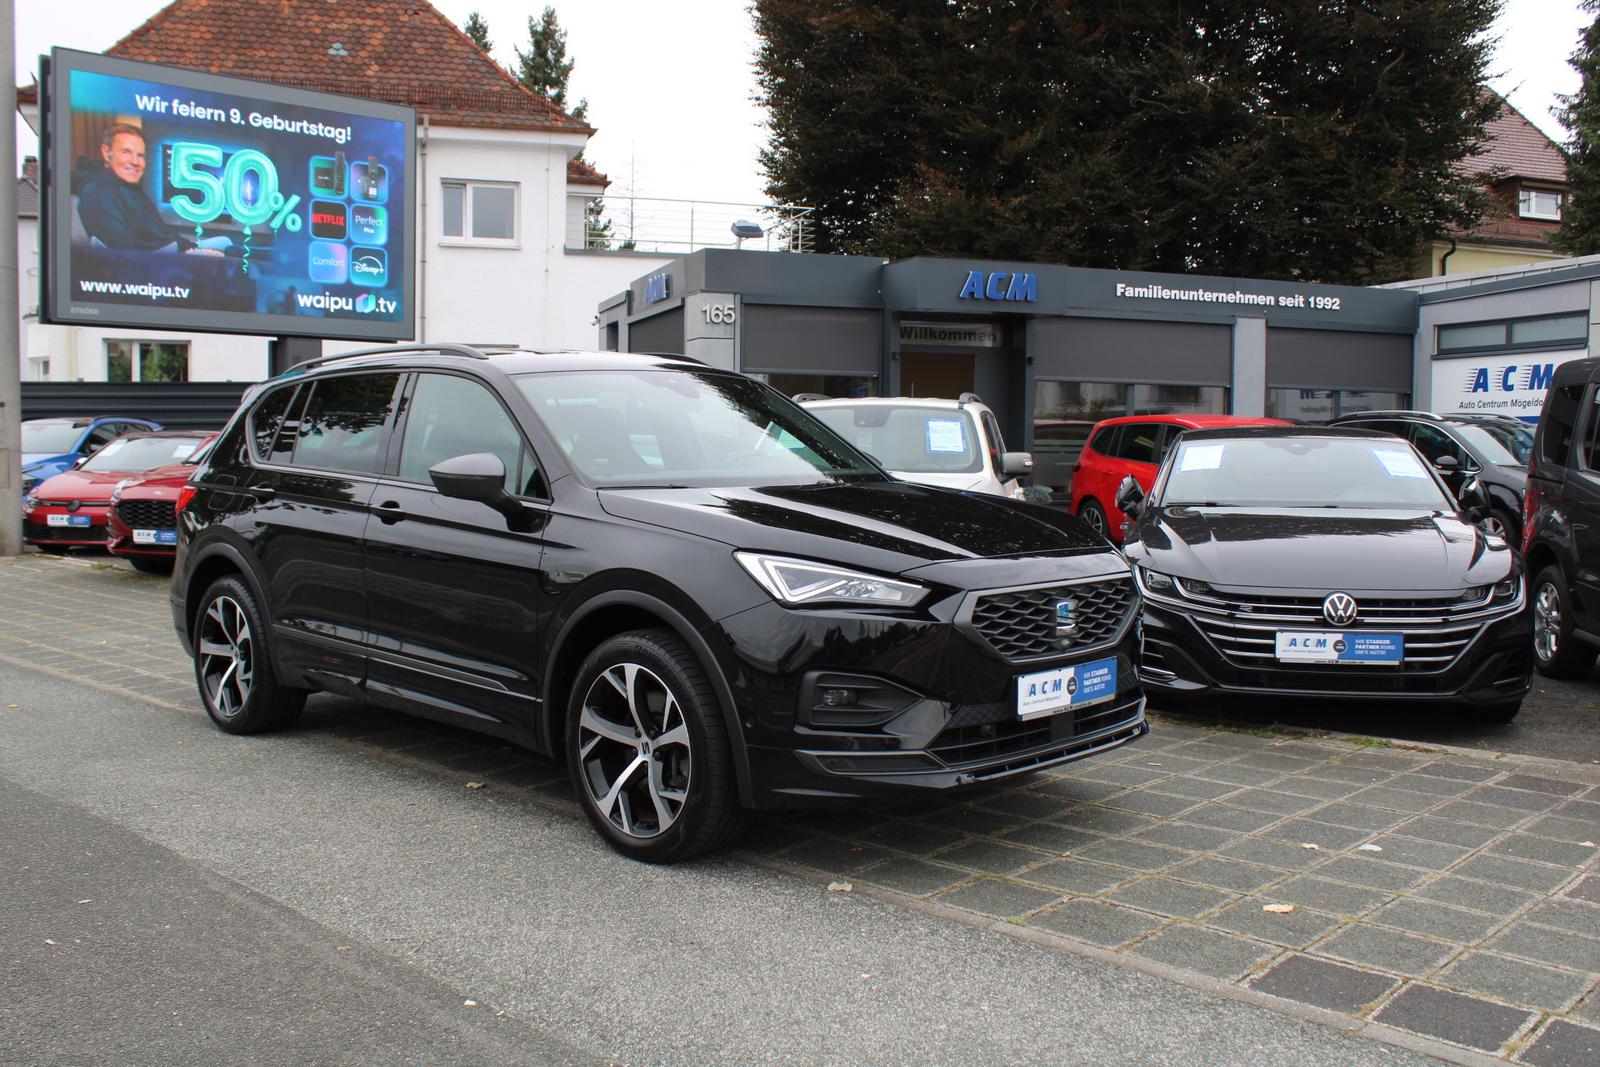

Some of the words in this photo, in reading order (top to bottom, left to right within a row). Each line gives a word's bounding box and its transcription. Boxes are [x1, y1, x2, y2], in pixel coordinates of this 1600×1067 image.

[135, 94, 168, 113] Wir
[172, 99, 225, 122] feiern
[230, 108, 245, 125] 9.
[249, 112, 352, 144] Geburtstag!
[170, 142, 302, 232] 50%
[312, 213, 344, 226] NETFLIX
[355, 215, 384, 227] Perfect
[313, 256, 344, 267] Comfort
[80, 280, 190, 299] www.waipu.tv
[960, 270, 1038, 302] ACM
[297, 291, 353, 312] waipu
[1116, 283, 1275, 306] Familienunternehmen
[1278, 295, 1304, 308] seit
[1308, 296, 1340, 310] 1992
[702, 304, 735, 324] 165
[900, 326, 997, 343] Willkommen
[1459, 401, 1475, 409] Auto
[1477, 400, 1508, 409] Centrum
[1510, 398, 1544, 409] Mögeldo
